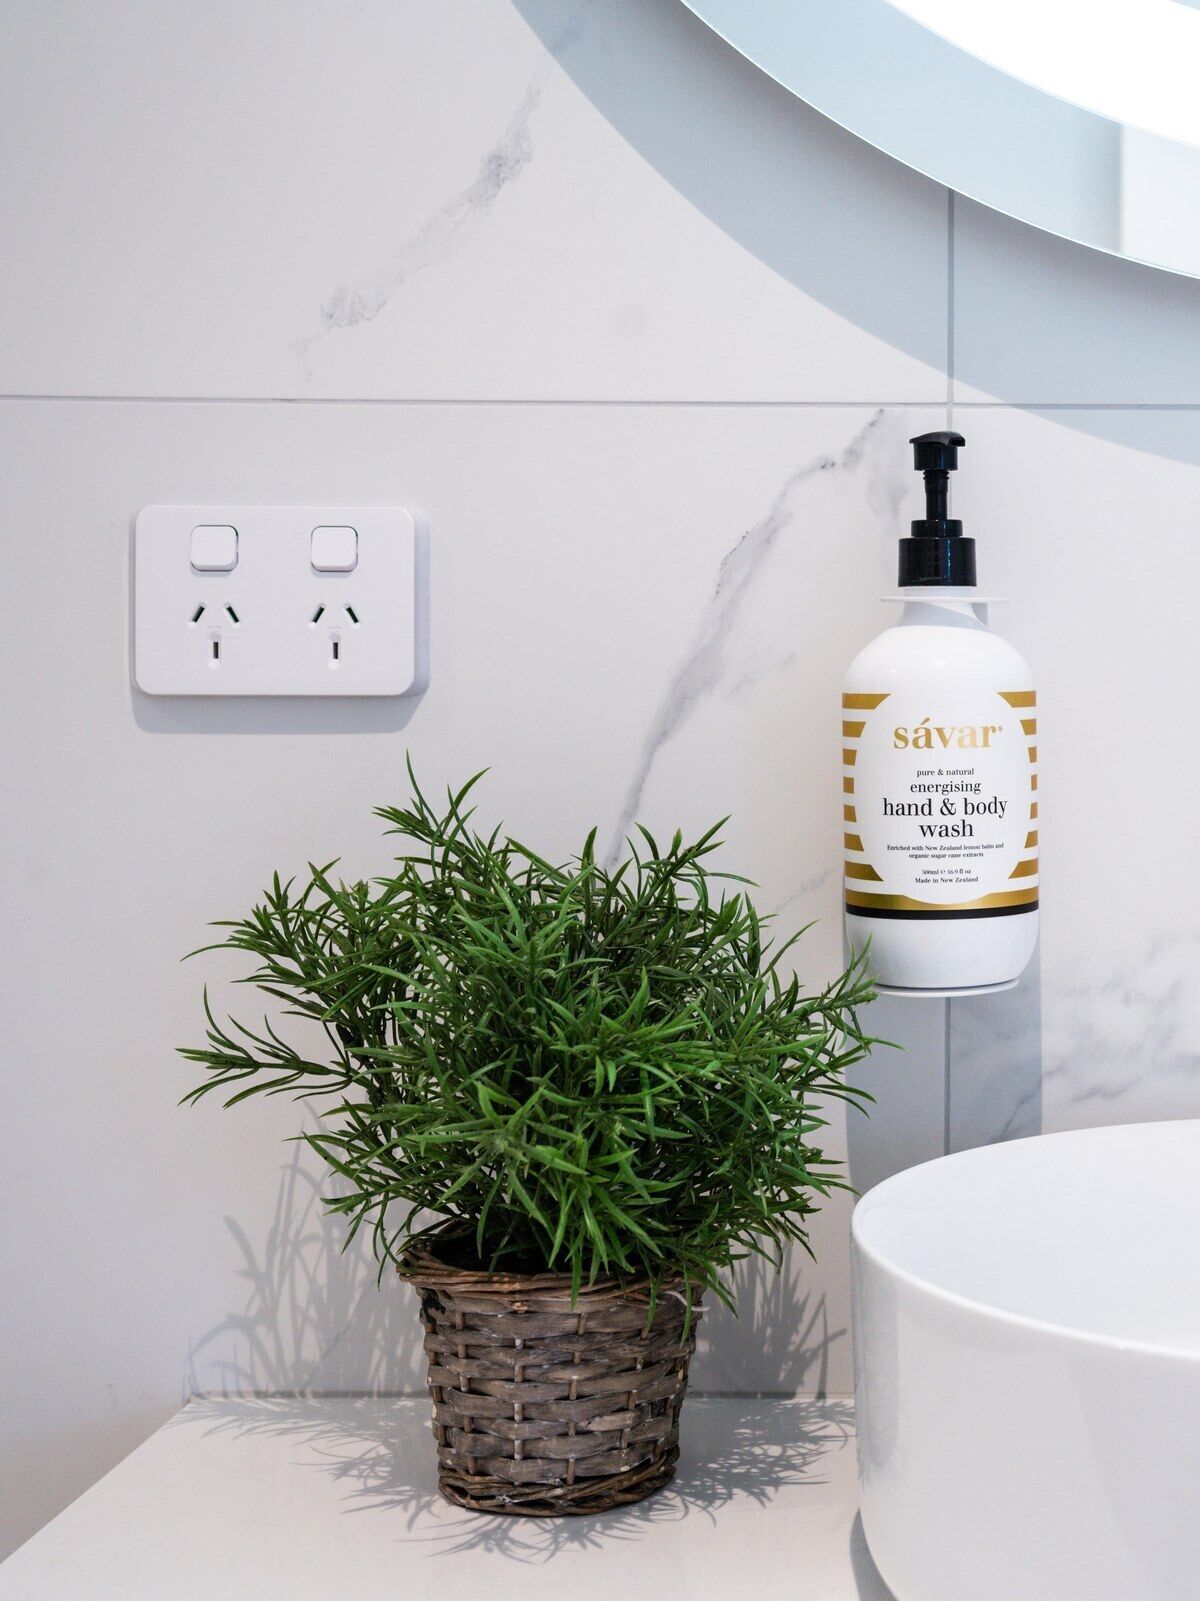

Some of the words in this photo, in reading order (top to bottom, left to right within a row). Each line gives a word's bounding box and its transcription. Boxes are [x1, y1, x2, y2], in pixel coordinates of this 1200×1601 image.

[916, 770, 935, 778] pure
[937, 768, 944, 776] &
[946, 768, 975, 776] natural
[910, 780, 981, 795] energising
[883, 797, 933, 816] hand
[940, 797, 957, 816] &
[963, 796, 1008, 818] body
[919, 819, 975, 838] wash
